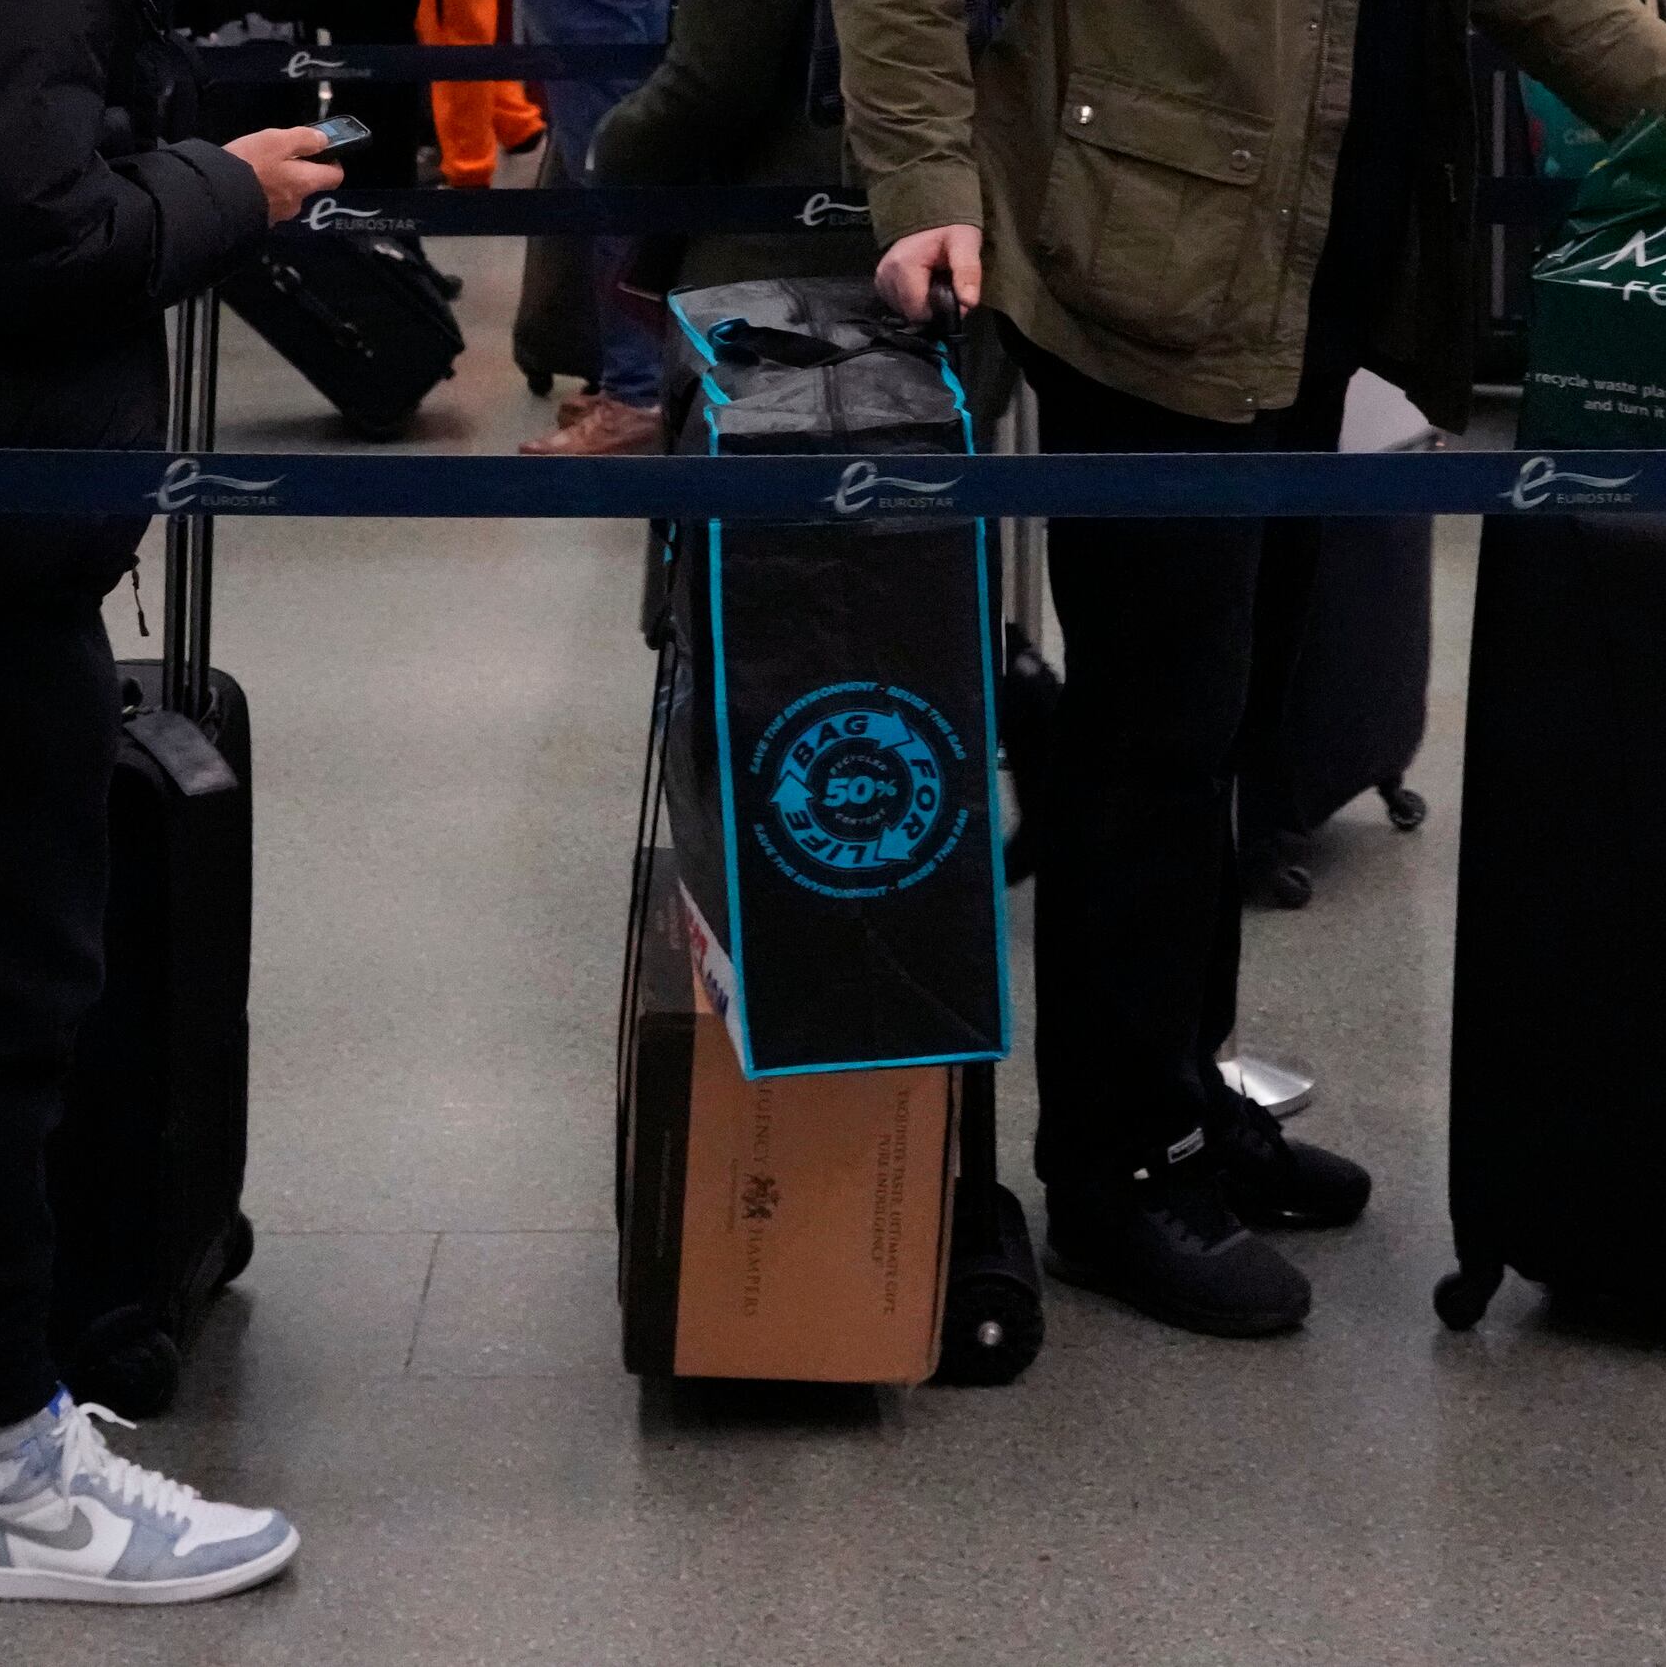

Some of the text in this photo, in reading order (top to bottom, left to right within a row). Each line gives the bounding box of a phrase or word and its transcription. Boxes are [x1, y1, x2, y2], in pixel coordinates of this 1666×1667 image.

[335, 218, 416, 231] EUROSTAR
[1536, 373, 1589, 389] recycle
[1594, 378, 1637, 394] waste
[1584, 398, 1613, 413] and
[1618, 401, 1650, 417] turn
[1653, 405, 1665, 419] it
[200, 495, 277, 507] EUROSTAR
[879, 496, 954, 509] EUROSTAR
[1557, 493, 1634, 505] EUROSTAR
[749, 739, 769, 775] SAVE
[764, 714, 786, 739] THE
[783, 680, 879, 719] ENVIRONMENT
[947, 732, 967, 760] BAG
[784, 715, 937, 864] BAG FOR LIFE
[821, 775, 897, 808] 50%
[753, 823, 776, 856] SAVE
[793, 873, 888, 899] ENVIRONMENT
[877, 1134, 893, 1169] PURE
